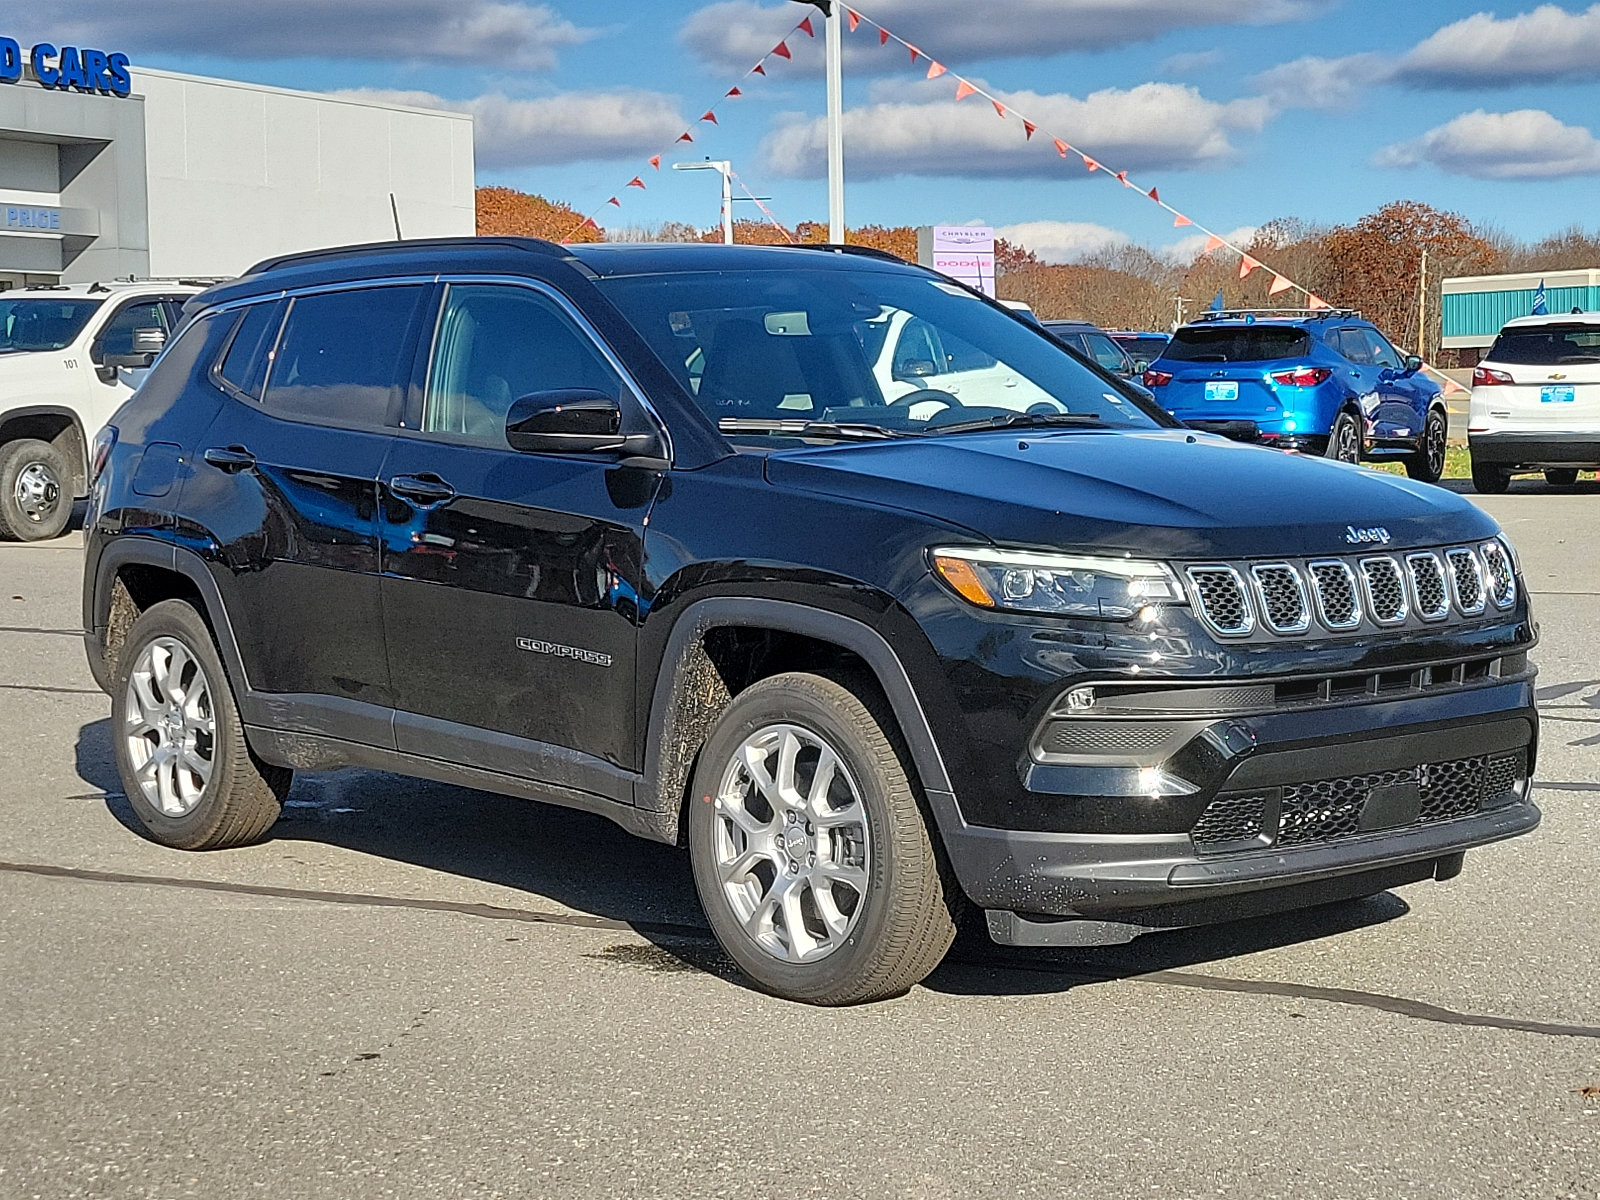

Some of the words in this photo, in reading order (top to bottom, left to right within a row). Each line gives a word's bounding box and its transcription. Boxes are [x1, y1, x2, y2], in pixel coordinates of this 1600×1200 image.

[31, 43, 131, 98] CARS
[6, 207, 60, 229] PRICE
[63, 359, 79, 370] 101
[1346, 525, 1391, 545] Jeep
[516, 636, 613, 667] COMPASS
[873, 817, 885, 890] YOKOHAMA
